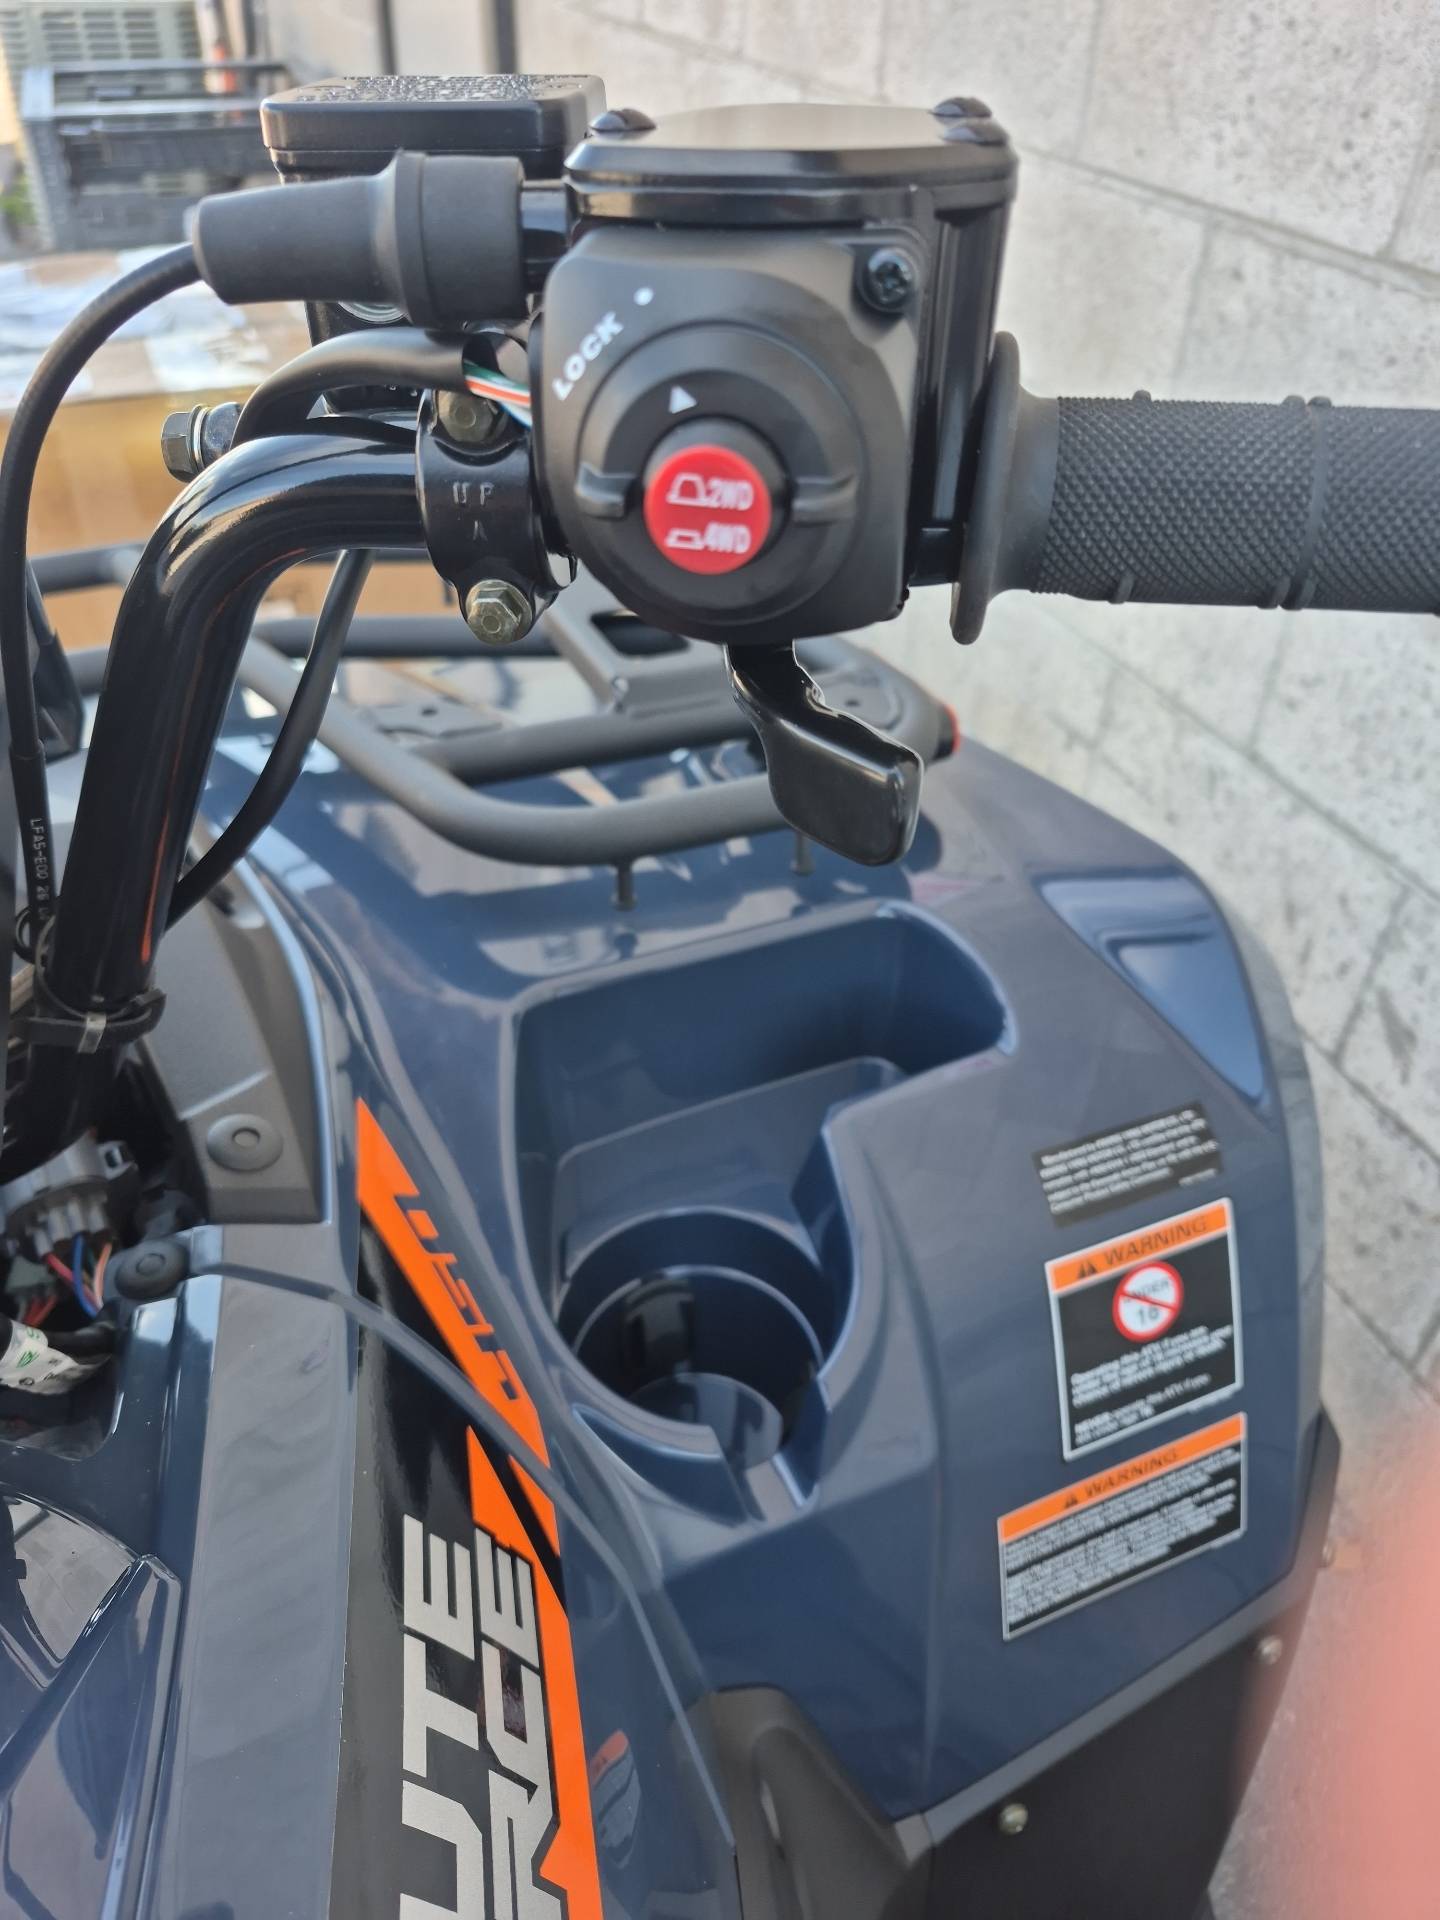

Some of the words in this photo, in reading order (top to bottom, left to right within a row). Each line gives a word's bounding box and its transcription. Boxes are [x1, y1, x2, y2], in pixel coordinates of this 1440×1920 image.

[552, 311, 624, 401] LOCK
[452, 481, 494, 505] UP
[707, 477, 754, 511] 2WD
[704, 521, 751, 554] 4WD
[1102, 1215, 1208, 1266] WARNING
[1084, 1449, 1179, 1498] WARNING
